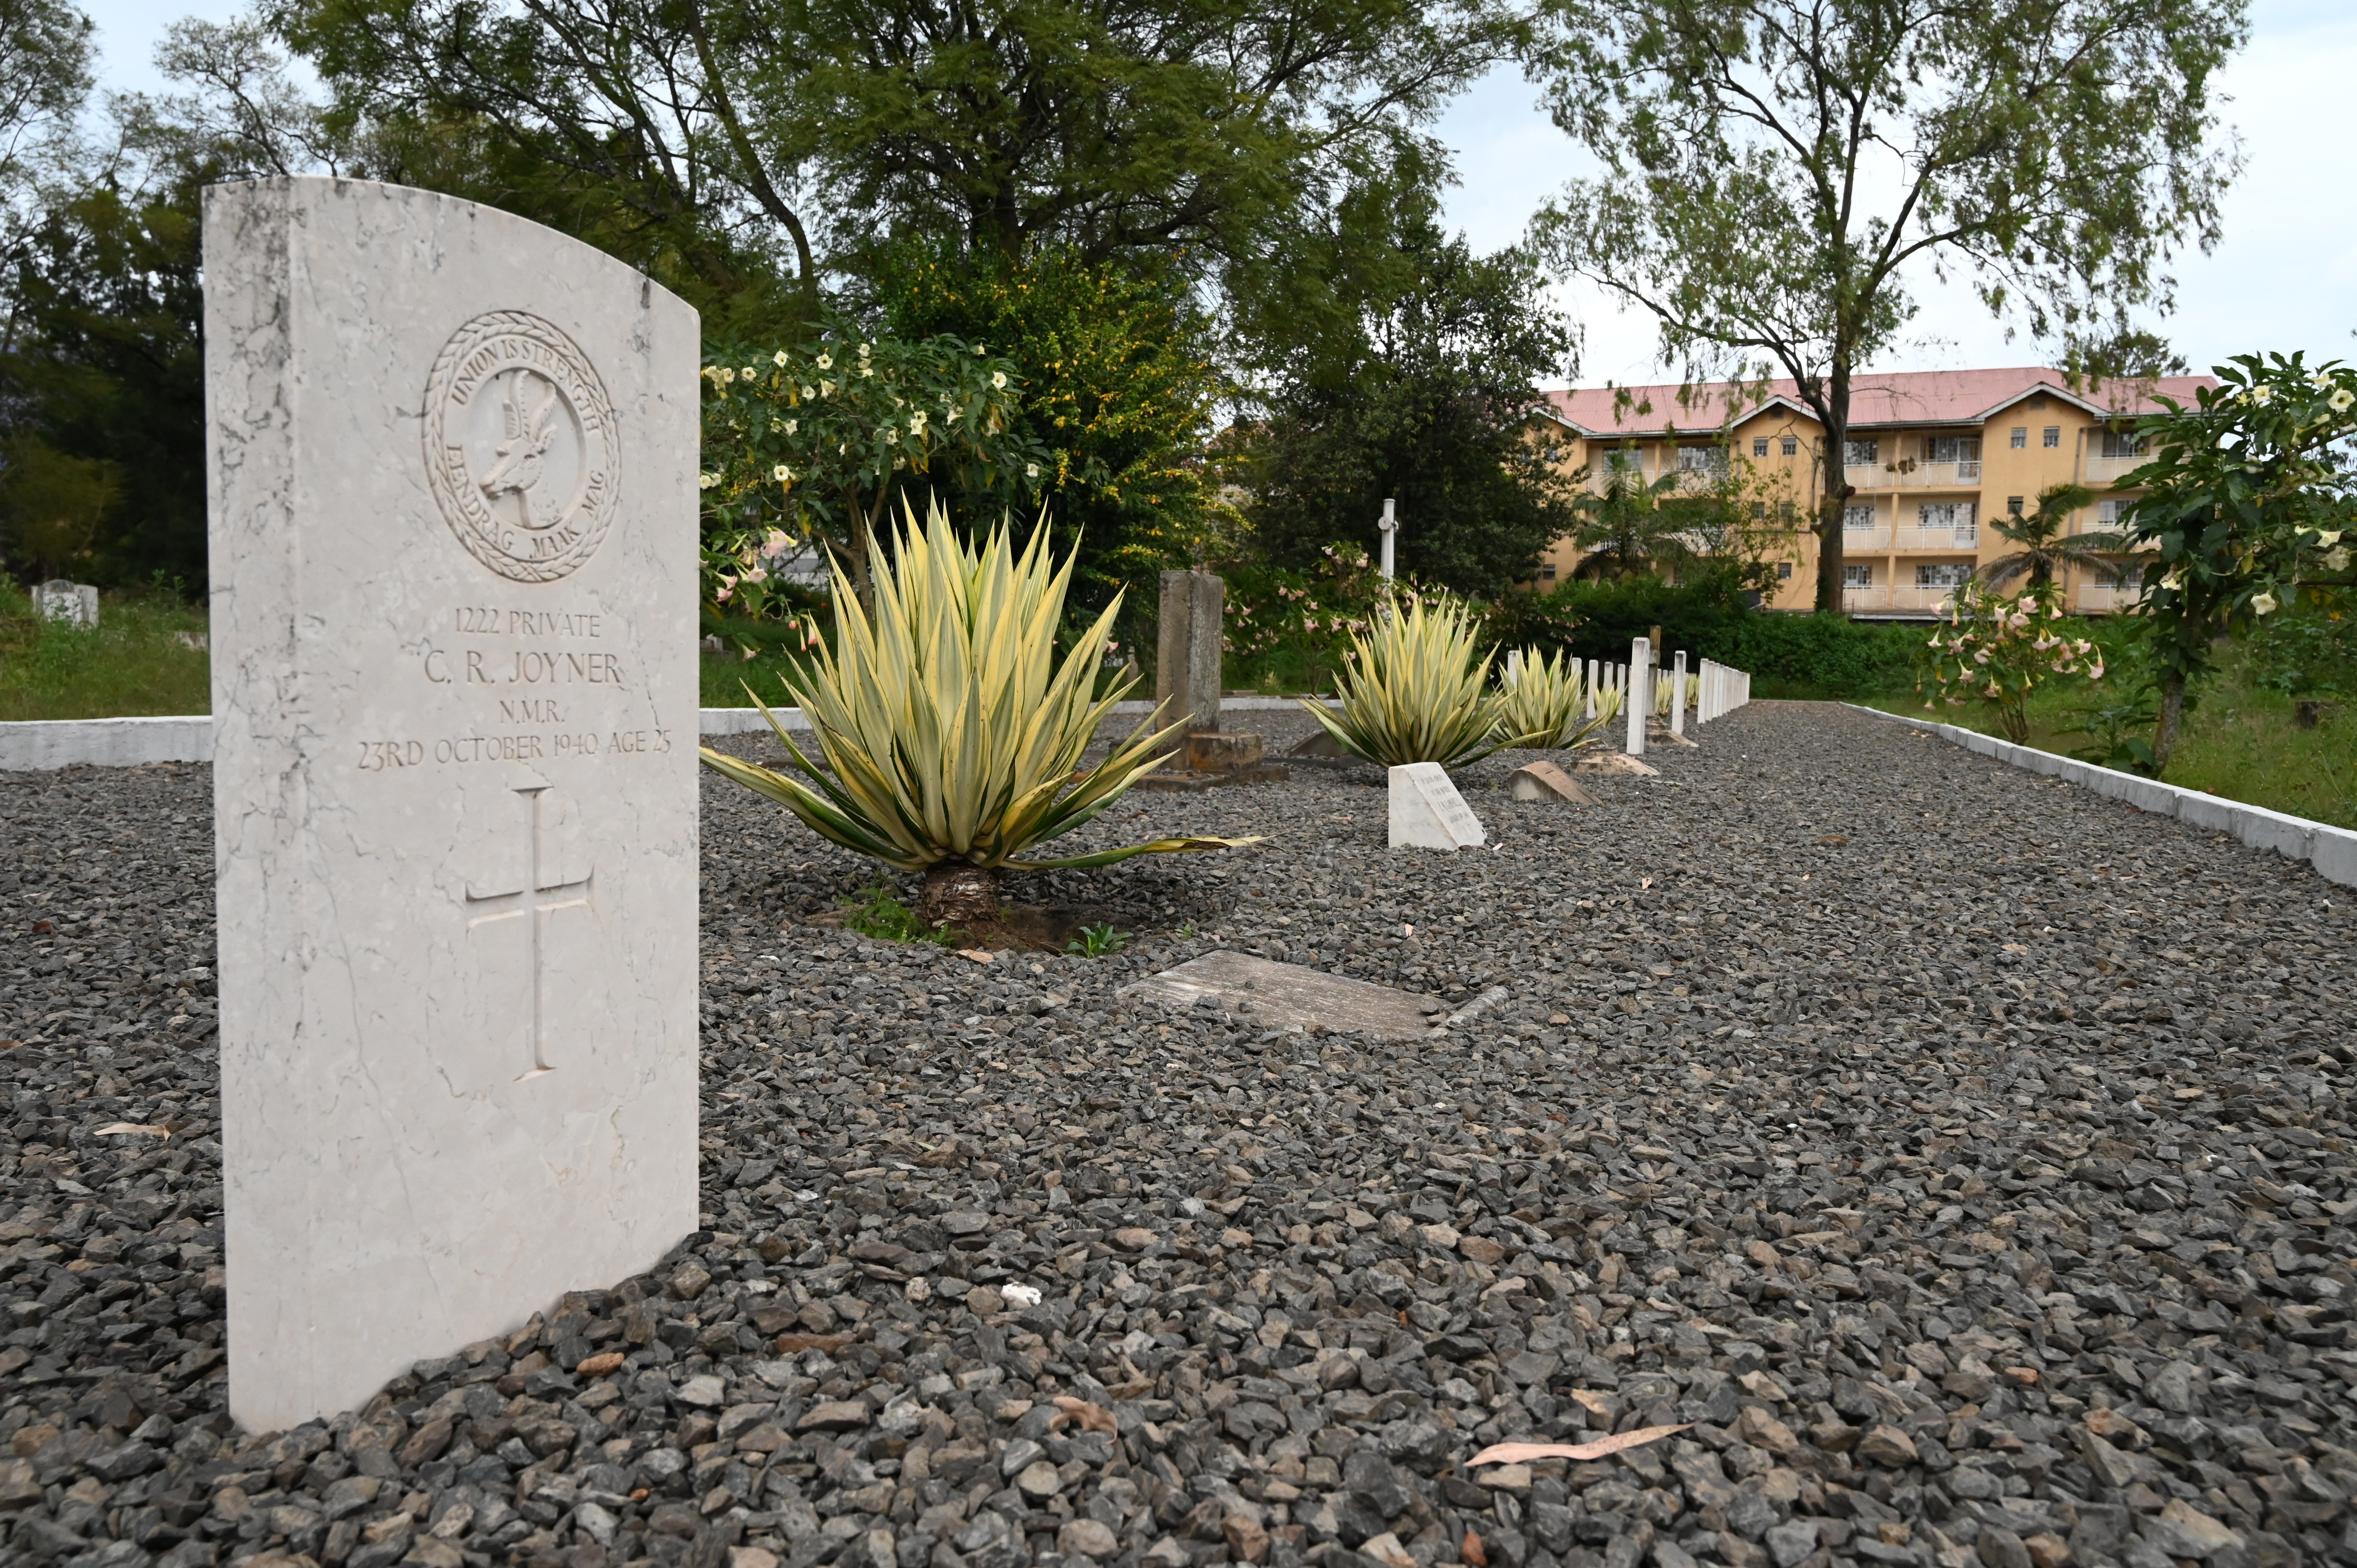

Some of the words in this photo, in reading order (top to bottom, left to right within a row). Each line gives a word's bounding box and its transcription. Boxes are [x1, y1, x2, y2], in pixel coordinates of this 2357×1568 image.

[451, 343, 500, 405] UNION
[501, 339, 519, 359] IS
[522, 340, 599, 431] STRENGTH
[447, 444, 514, 550] EENDRAG
[532, 523, 581, 557] MAAK
[581, 470, 604, 517] MAG
[456, 607, 500, 634] 1222
[510, 611, 600, 638] PRIVATE
[424, 650, 451, 684] C.
[467, 650, 495, 683] R.
[509, 652, 622, 683] JOYNER
[499, 700, 565, 724] N.M.R.
[358, 741, 424, 772] 23RD
[435, 736, 544, 764] OCTOBER
[554, 733, 599, 756] 1940
[608, 731, 645, 753] AGE
[654, 729, 671, 753] 25
